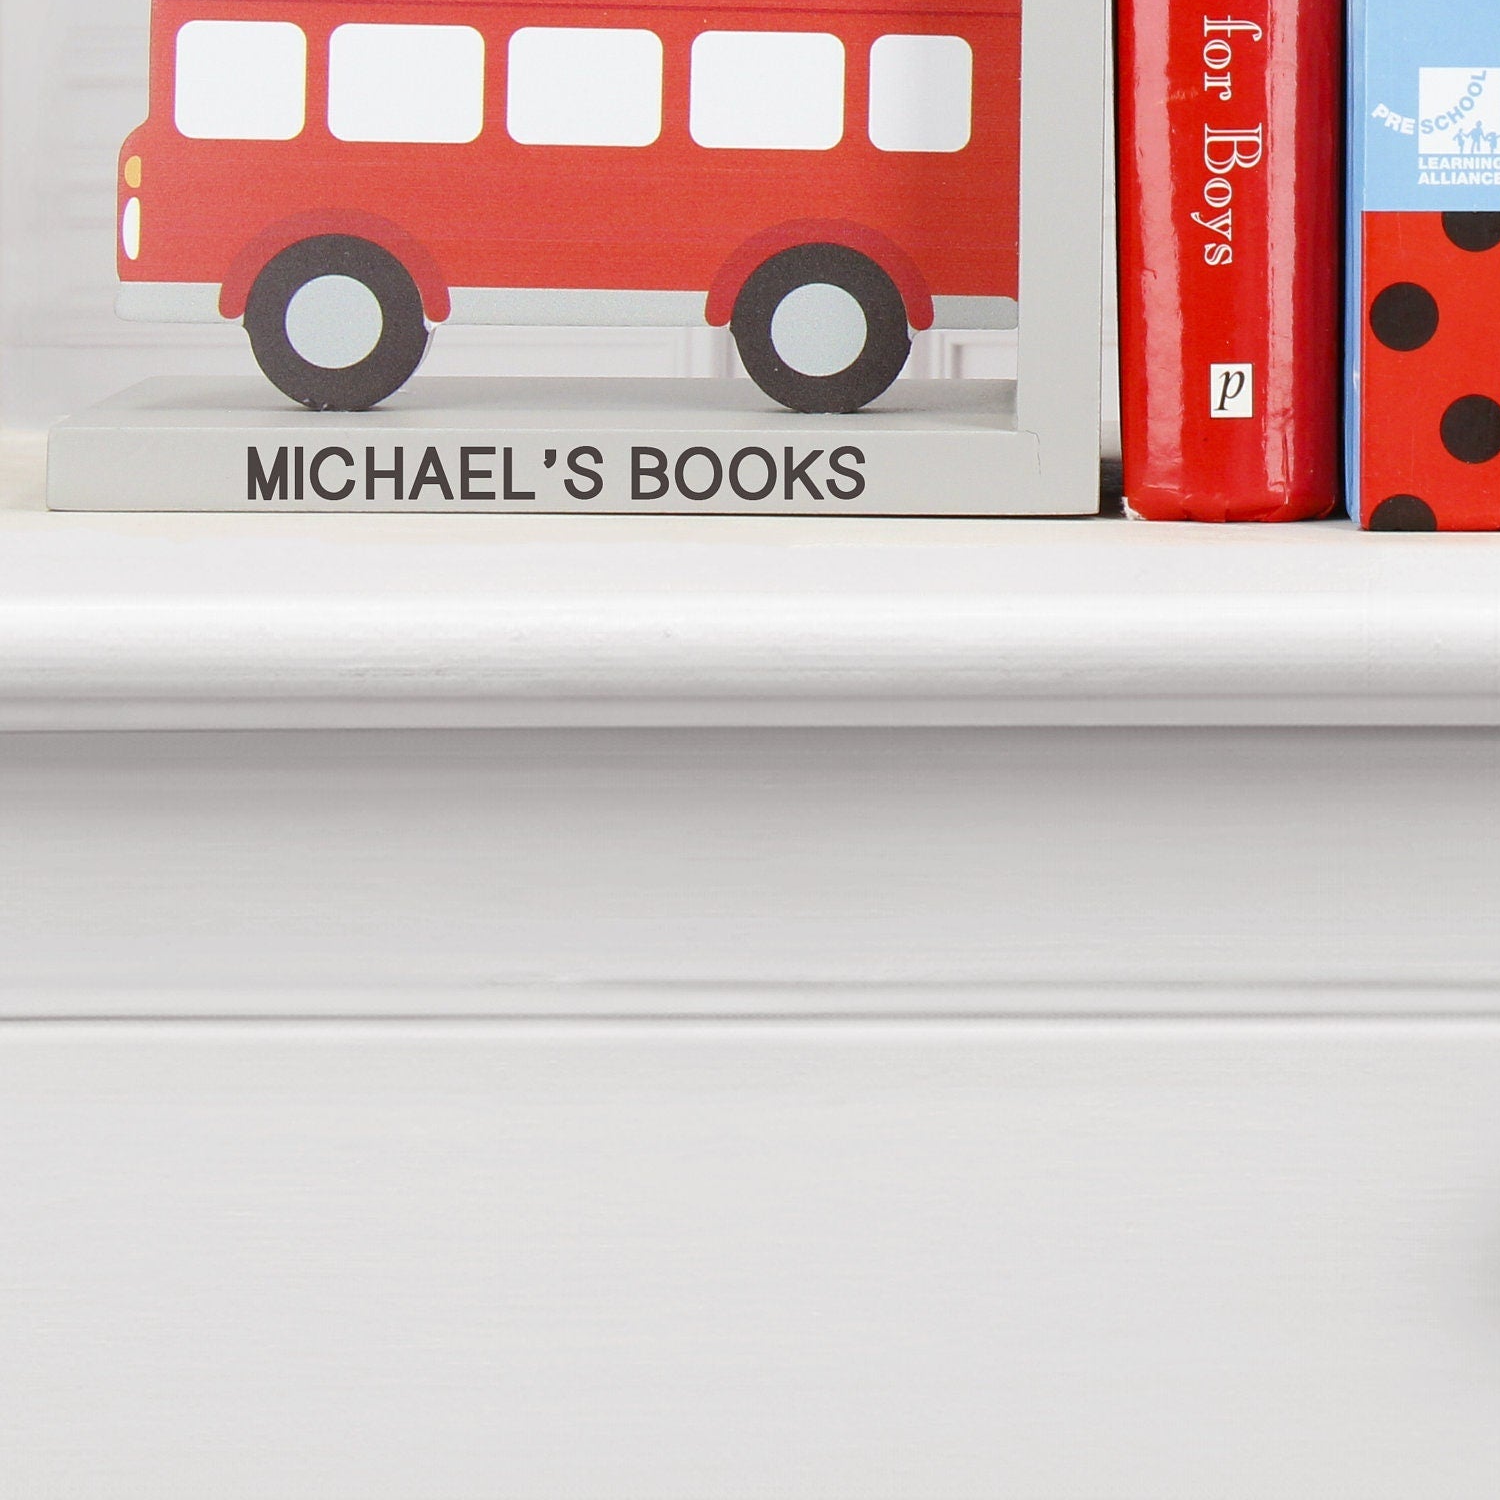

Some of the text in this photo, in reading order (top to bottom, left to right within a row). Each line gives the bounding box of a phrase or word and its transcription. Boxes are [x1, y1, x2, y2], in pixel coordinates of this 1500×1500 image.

[1203, 15, 1262, 101] for
[1191, 123, 1261, 266] Boys
[247, 446, 866, 501] MICHAEL'S BOOKS
